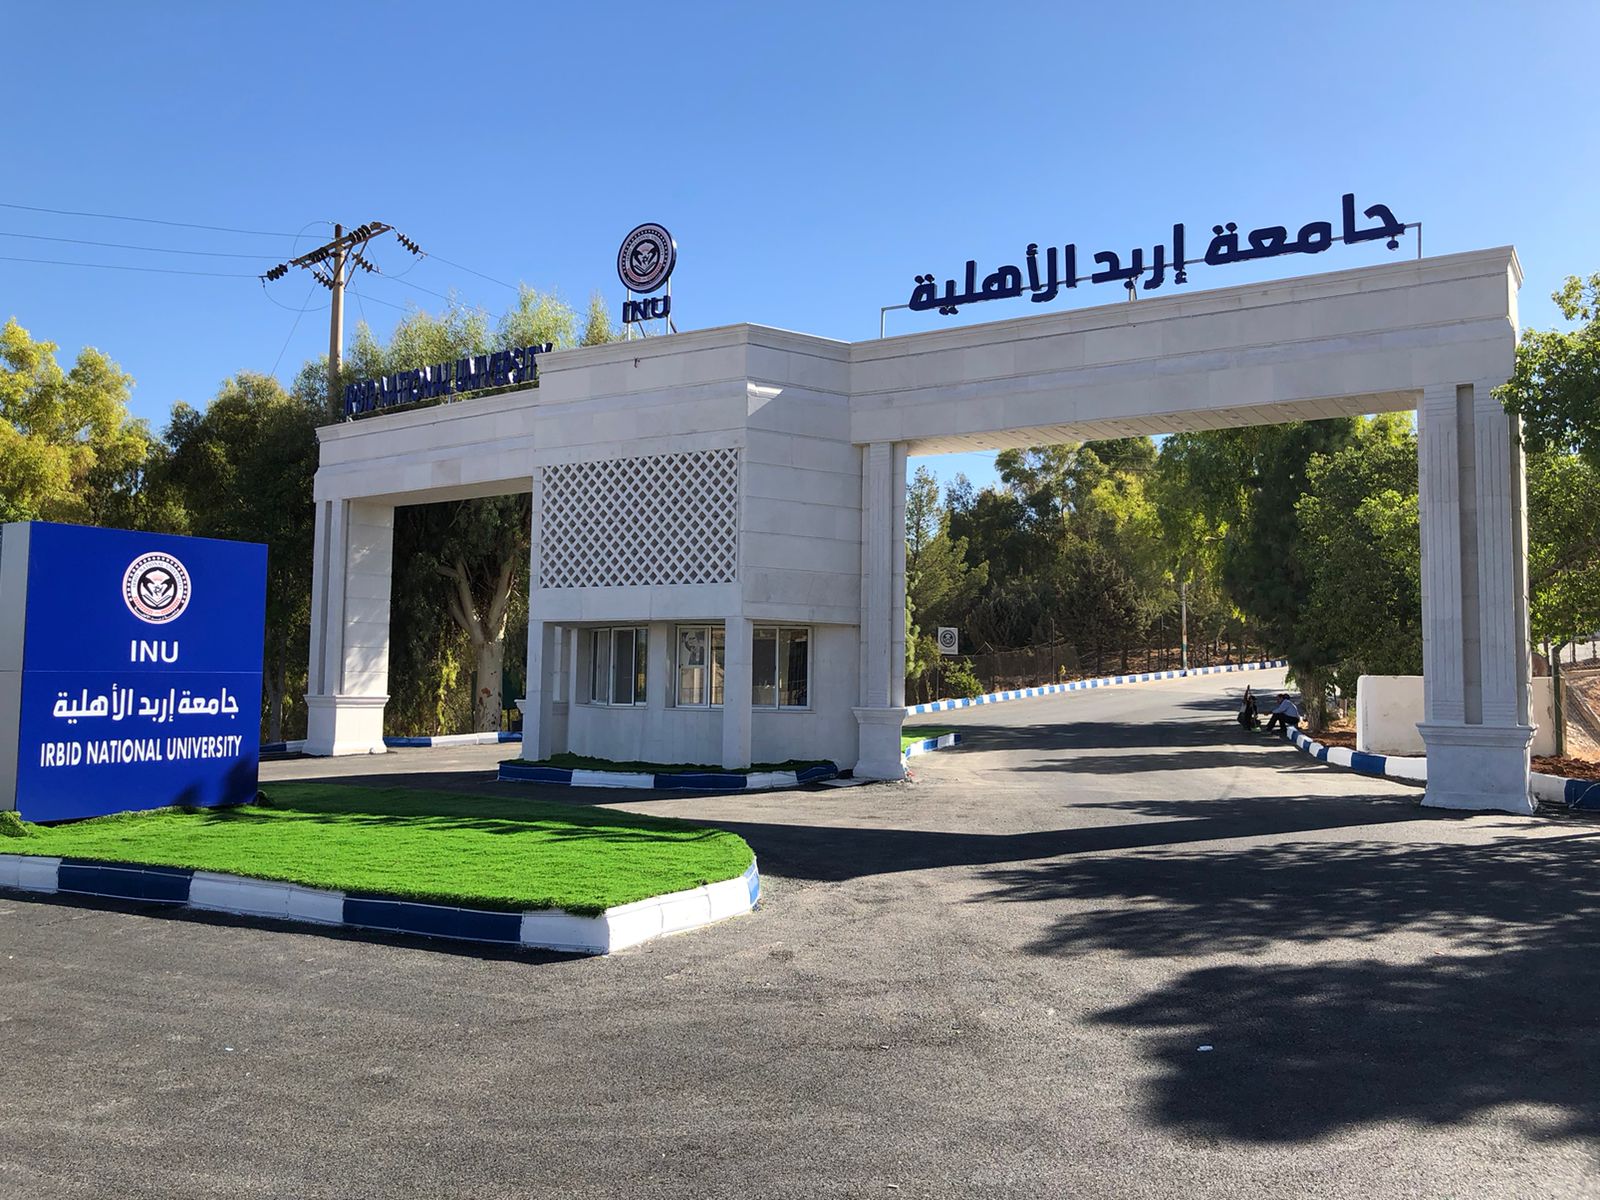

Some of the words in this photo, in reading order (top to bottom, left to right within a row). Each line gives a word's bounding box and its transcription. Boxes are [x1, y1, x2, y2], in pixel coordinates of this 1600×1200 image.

[1204, 193, 1403, 265] جامعة
[1091, 222, 1187, 290] إربد
[908, 243, 1077, 315] الأهلية
[622, 295, 671, 323] INU
[130, 640, 179, 663] INU
[53, 683, 134, 724] الأهلية
[139, 688, 175, 723] إربد
[177, 688, 239, 720] جامعة
[41, 741, 82, 767] IRBID
[87, 738, 163, 765] NATIONAL
[167, 735, 243, 760] UNIVERSITY
